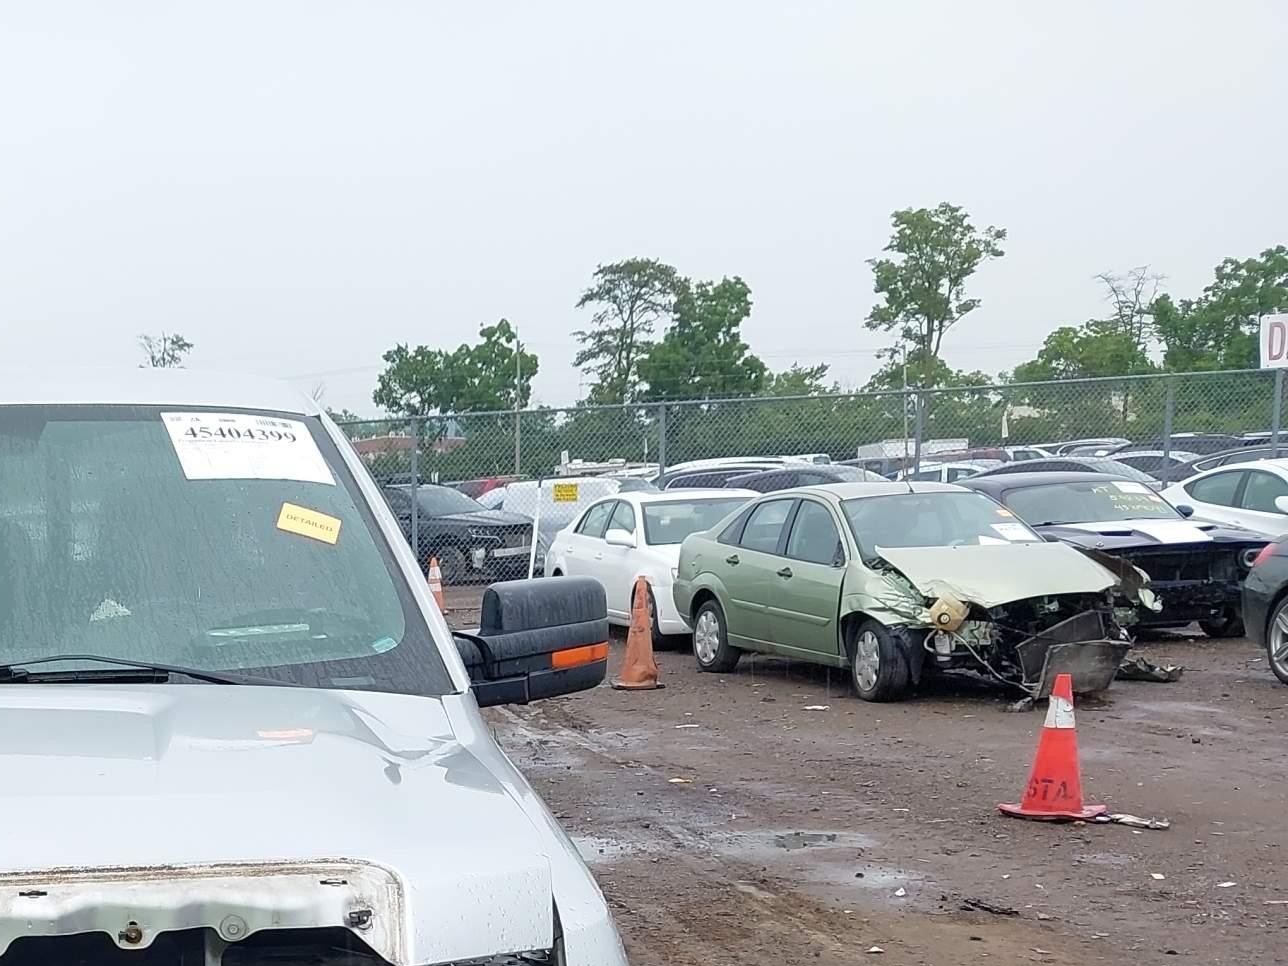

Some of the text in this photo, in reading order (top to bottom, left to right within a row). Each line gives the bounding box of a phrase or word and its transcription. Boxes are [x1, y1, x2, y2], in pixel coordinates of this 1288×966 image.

[1269, 321, 1288, 361] D
[184, 426, 297, 443] 45404399
[286, 513, 333, 533] DETAILED
